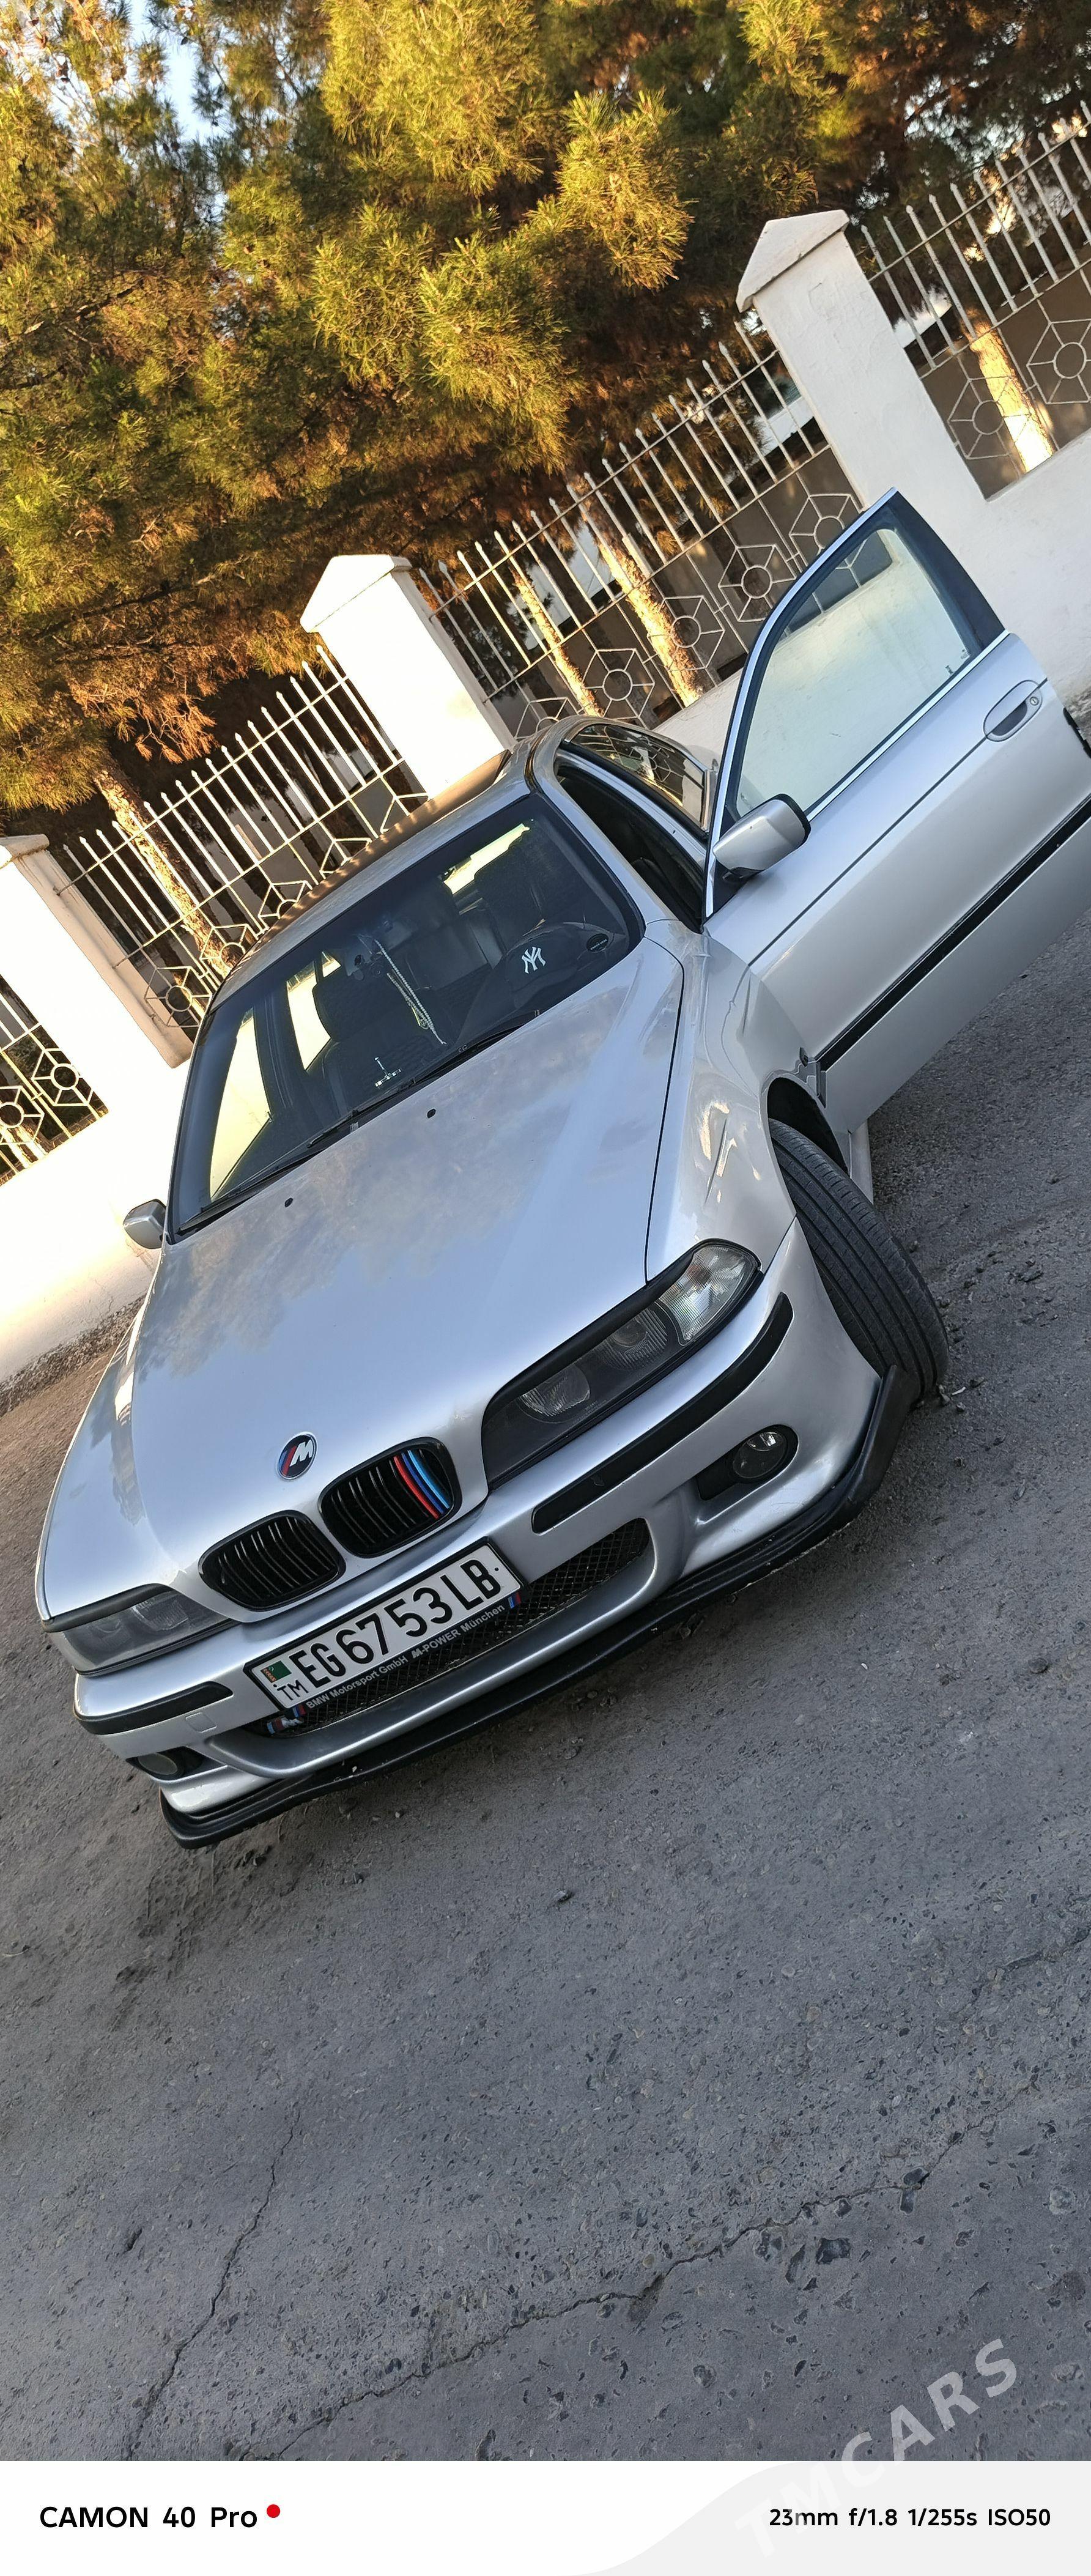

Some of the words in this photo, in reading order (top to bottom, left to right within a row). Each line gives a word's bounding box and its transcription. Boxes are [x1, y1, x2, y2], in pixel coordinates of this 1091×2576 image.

[289, 1439, 313, 1467] M
[306, 1692, 330, 1709] BMW
[330, 1671, 380, 1698] Motorsport
[379, 1656, 409, 1674] GmbH
[411, 1629, 462, 1659] M-POWER
[460, 1604, 506, 1633] München
[277, 1680, 309, 1701] TM
